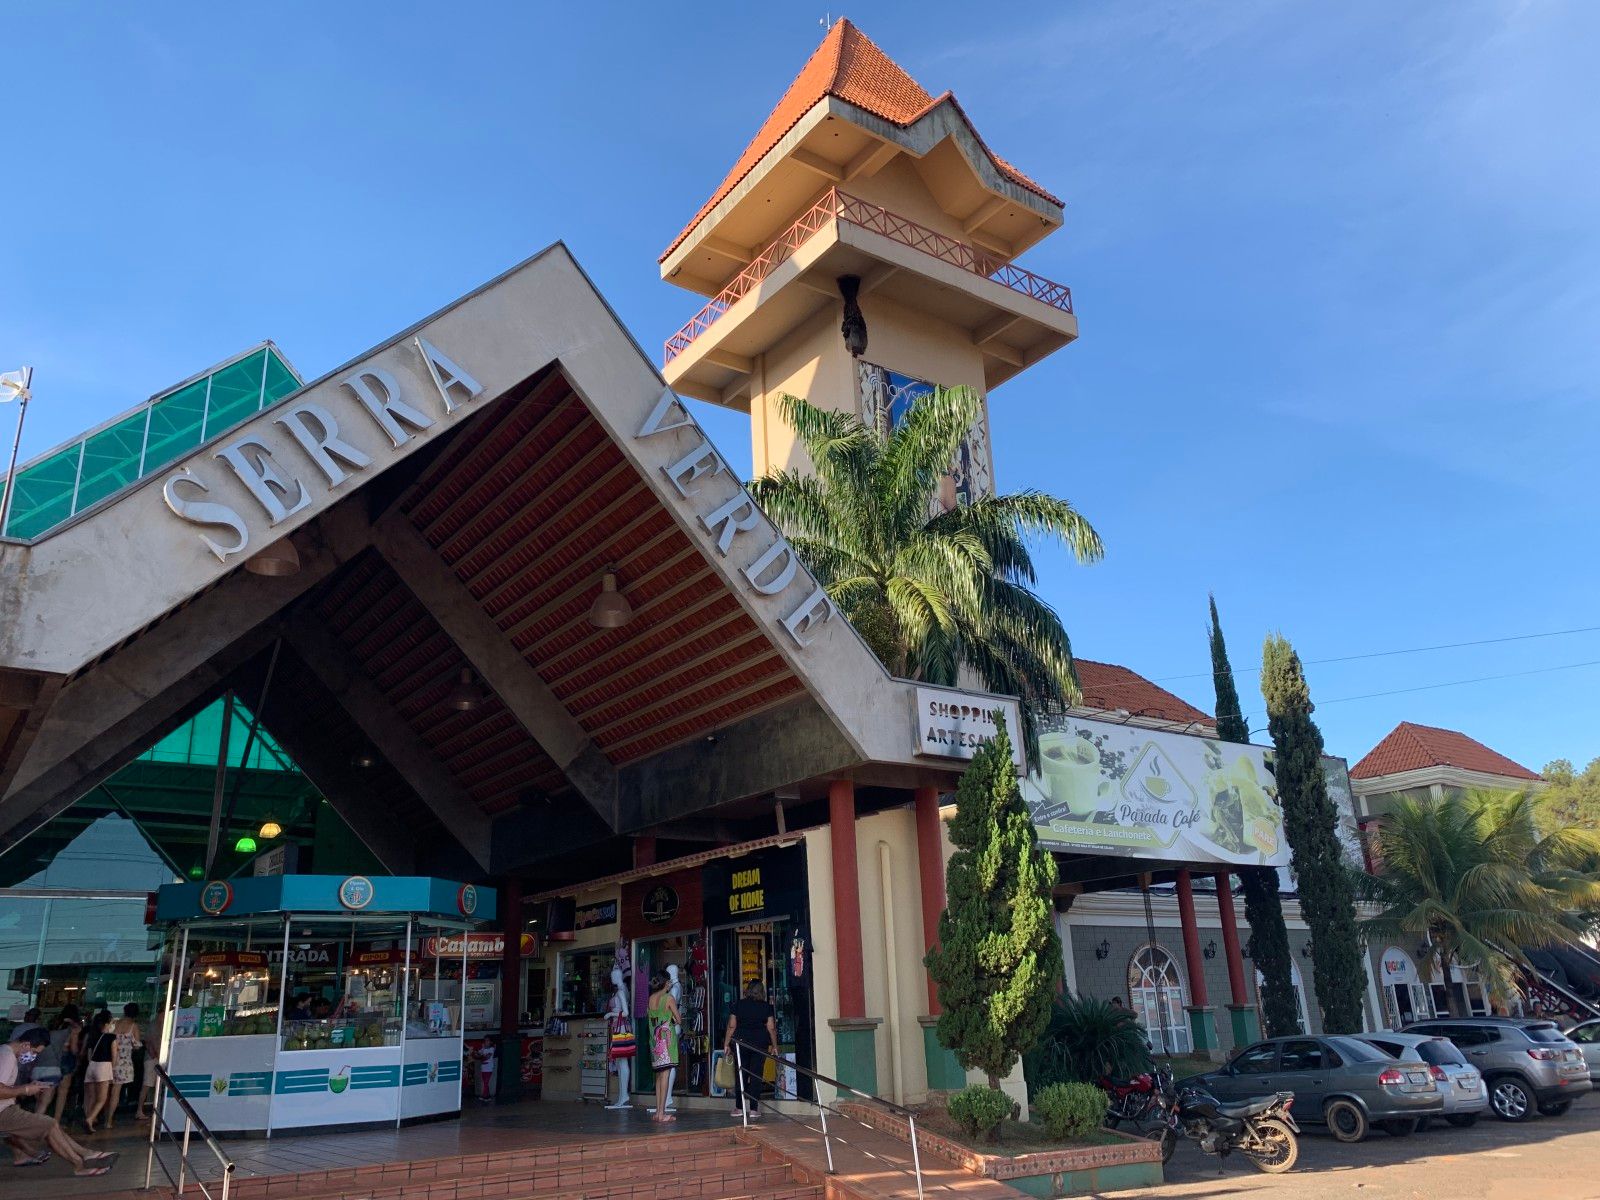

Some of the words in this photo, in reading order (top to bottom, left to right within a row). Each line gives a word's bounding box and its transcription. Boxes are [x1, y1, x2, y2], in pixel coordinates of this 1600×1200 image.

[163, 335, 487, 563] SERRA
[634, 387, 838, 648] VERDE
[929, 701, 1006, 725] SHOPPIN
[1120, 804, 1168, 825] Parada
[1172, 809, 1200, 829] Café
[1053, 822, 1094, 836] Cafeteria
[1103, 828, 1152, 841] Lanchonete
[731, 867, 761, 890] DREAM
[728, 894, 739, 912] OF
[740, 889, 764, 910] HOME
[435, 937, 504, 953] Caramb
